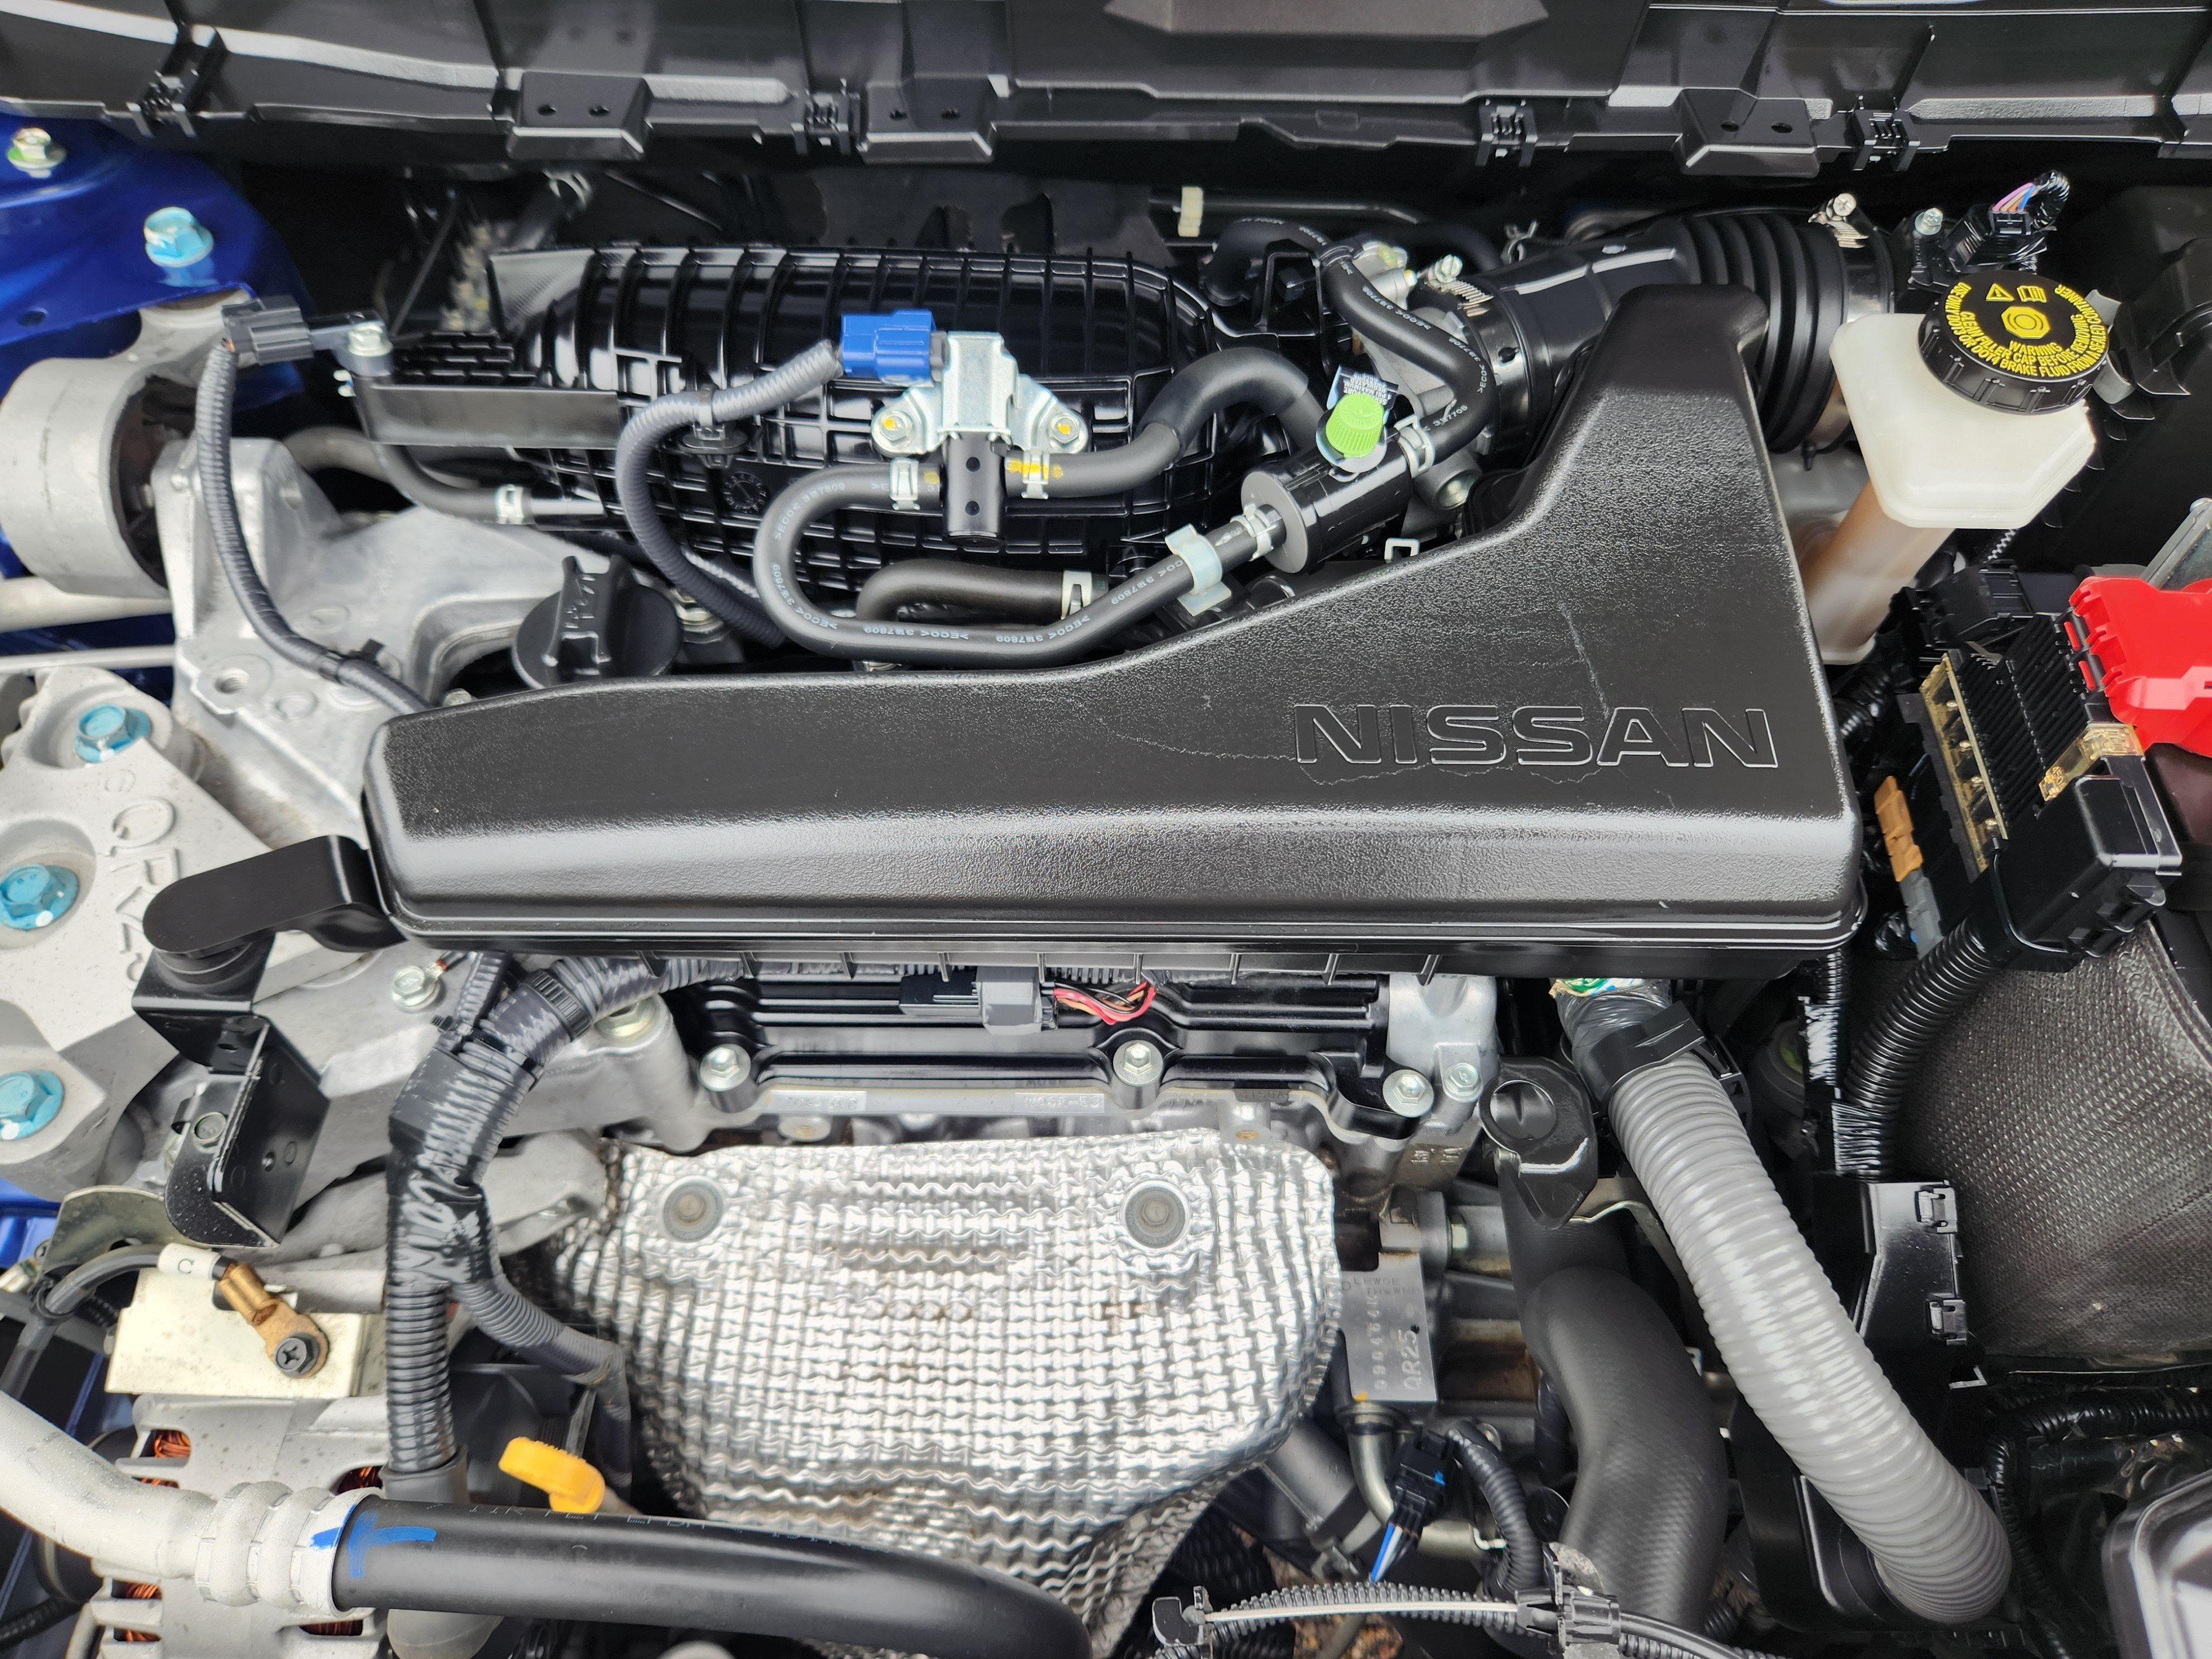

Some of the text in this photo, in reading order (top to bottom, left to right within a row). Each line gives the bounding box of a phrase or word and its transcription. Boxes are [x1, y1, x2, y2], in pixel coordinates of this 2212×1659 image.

[1945, 282, 2106, 377] USE ONLY DOT3 OR DOT4 BRAKE FLUID FROM A SEALED CONTAINER
[1960, 311, 2090, 367] CLEAN FILLER CAP BEFORE REMOVING
[2009, 341, 2062, 356] WARNING
[1294, 703, 1778, 769] NISSAN
[1397, 1329, 1422, 1390] QR25
